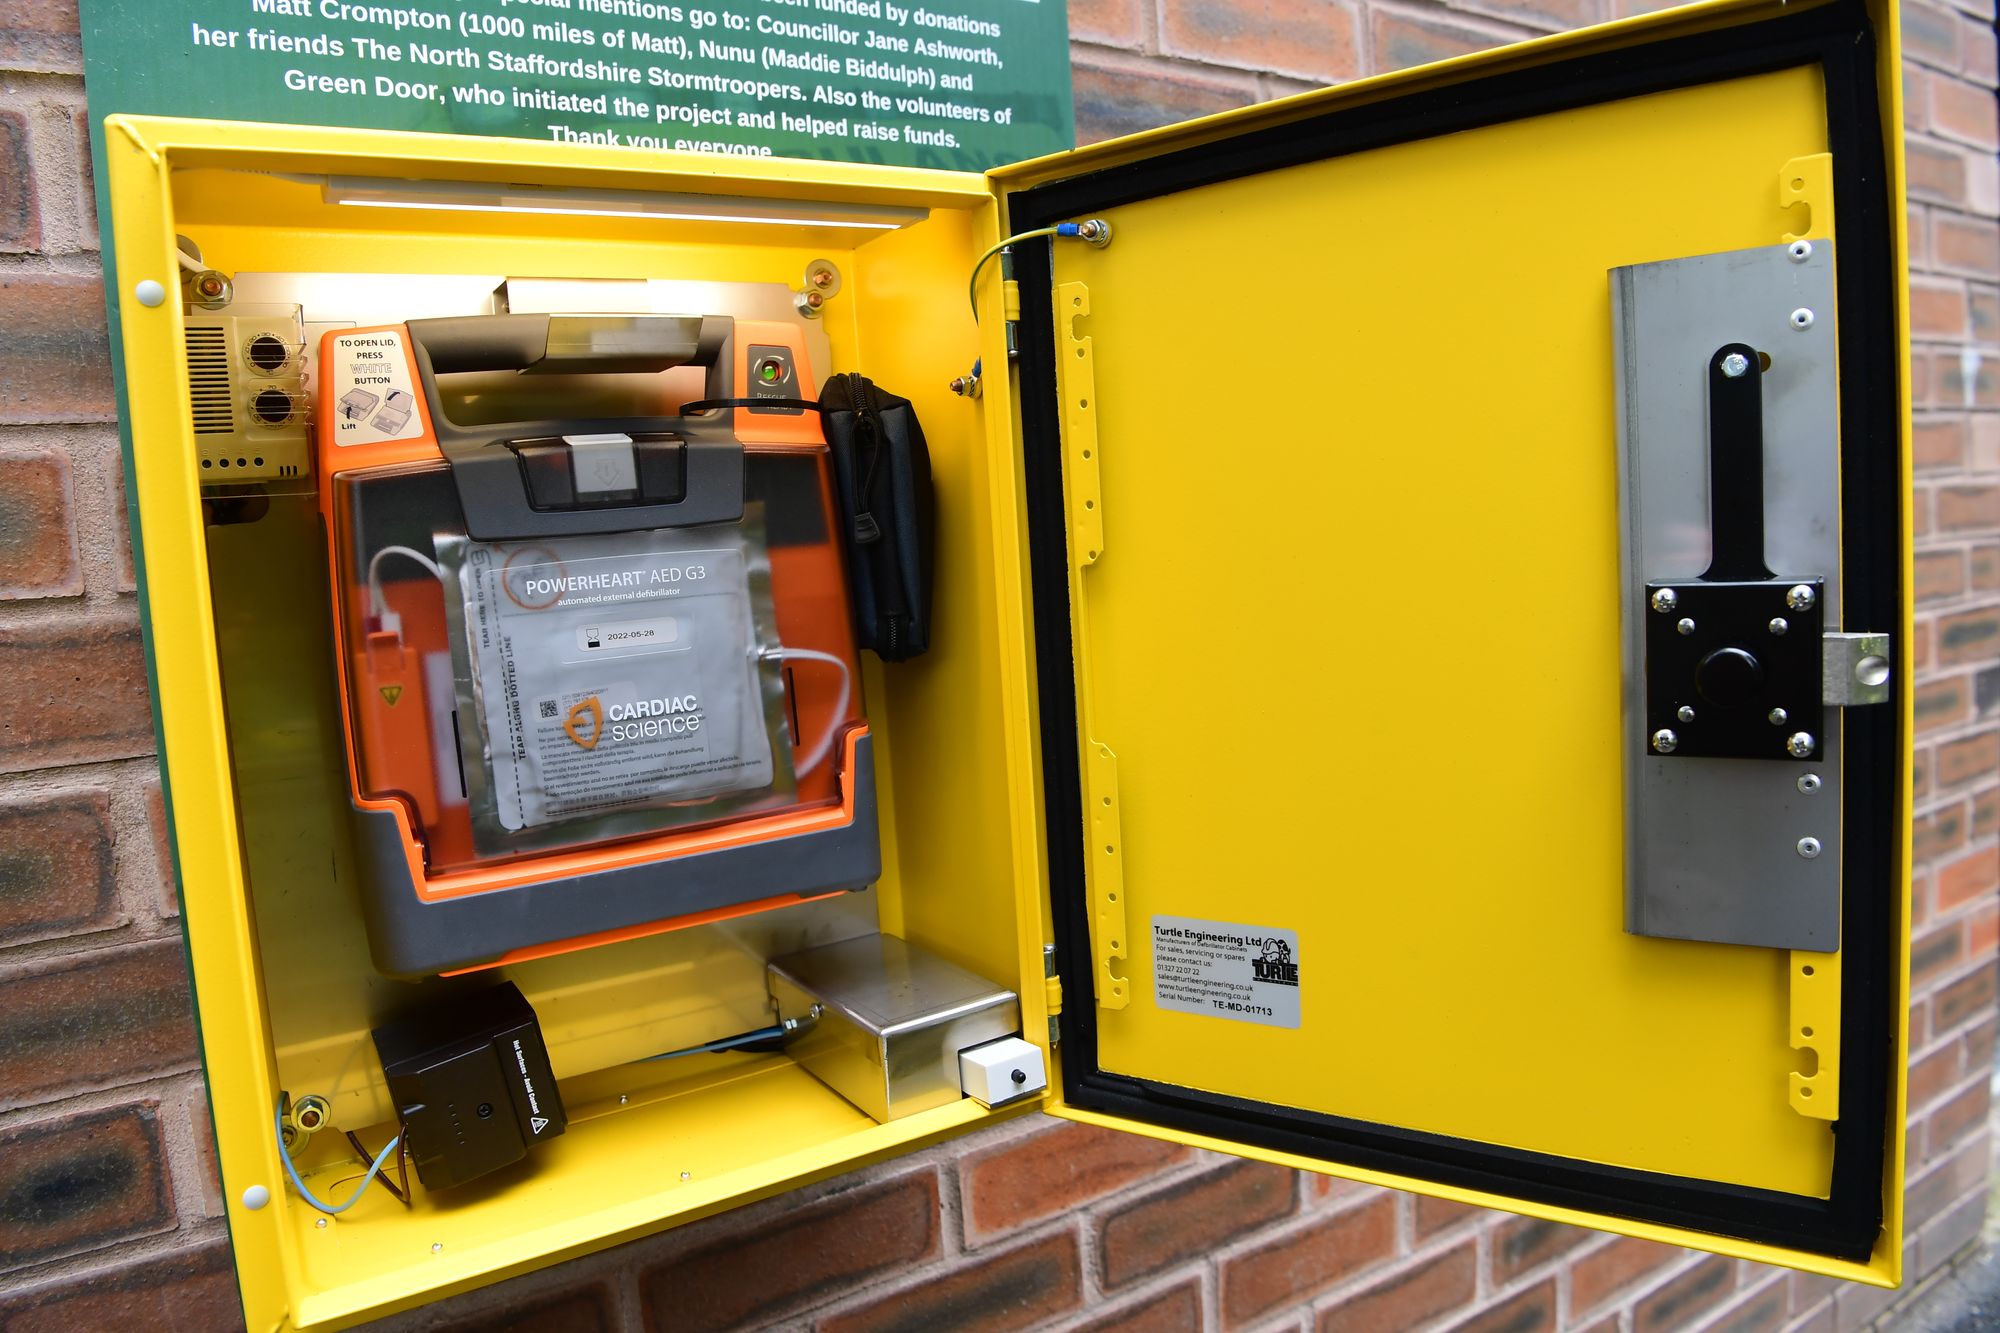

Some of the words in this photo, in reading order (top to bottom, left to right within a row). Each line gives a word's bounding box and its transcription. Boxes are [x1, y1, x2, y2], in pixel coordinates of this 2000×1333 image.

[885, 2, 909, 27] by
[913, 8, 1001, 37] donations
[578, 0, 683, 23] mentions
[690, 8, 717, 29] go
[722, 10, 750, 31] to:
[756, 14, 859, 45] Councillor
[864, 31, 909, 52] Jane
[914, 38, 1003, 70] Ashworth,
[252, 0, 312, 17] Matt
[320, 0, 451, 30] Crompton
[459, 12, 525, 37] (1000
[532, 22, 596, 46] miles
[602, 28, 625, 48] of
[631, 31, 693, 60] Matt),
[699, 39, 756, 63] Nunu
[762, 46, 840, 74] (Maddie
[845, 57, 936, 90] Biddulph)
[940, 73, 973, 91] and
[192, 23, 239, 48] her
[247, 28, 345, 57] friends
[351, 38, 402, 62] The
[409, 42, 480, 69] North
[487, 50, 642, 84] Staffordshire
[648, 66, 807, 101] Stormtroopers.
[813, 85, 857, 107] Also
[860, 90, 892, 111] the
[896, 97, 990, 123] volunteers
[993, 108, 1012, 125] of
[284, 70, 366, 95] Green
[374, 76, 445, 105] Door,
[452, 84, 505, 106] who
[512, 87, 607, 115] initiated
[613, 97, 650, 118] the
[655, 103, 732, 128] project
[737, 111, 775, 130] and
[782, 112, 848, 138] helped
[853, 121, 900, 141] raise
[903, 126, 960, 148] funds.
[547, 126, 620, 146] Thank
[626, 134, 668, 150] you
[340, 339, 352, 347] TO
[353, 339, 378, 347] OPEN
[380, 338, 396, 348] LID,
[356, 351, 384, 360] PRESS
[350, 362, 392, 374] WHITE
[354, 377, 391, 385] BUTTON
[650, 567, 682, 584] AED
[685, 565, 706, 580] G3
[558, 594, 601, 606] automated
[602, 591, 634, 602] external
[636, 588, 681, 600] defibrillator
[607, 629, 655, 641] 2022-05-28
[503, 636, 513, 658] LINE
[507, 660, 519, 698] DOTTED
[609, 694, 697, 722] CARDIAC
[612, 714, 700, 741] science
[1154, 925, 1183, 938] Turtle
[1185, 929, 1243, 947] Engineering
[1245, 936, 1262, 947] Ltd
[1168, 946, 1185, 954] sales,
[1186, 949, 1214, 959] servicing
[1224, 953, 1246, 962] spares
[1225, 945, 1248, 953] Cabinets
[1156, 954, 1177, 963] please
[1178, 957, 1202, 966] contact
[1158, 973, 1253, 992] sales@turtleengineering.co.uk
[1158, 983, 1251, 1001] www.turtleengineering.co.uk
[1159, 992, 1176, 1000] Serial
[1177, 994, 1206, 1004] Number:
[1212, 1000, 1273, 1016] TE-MD-01713
